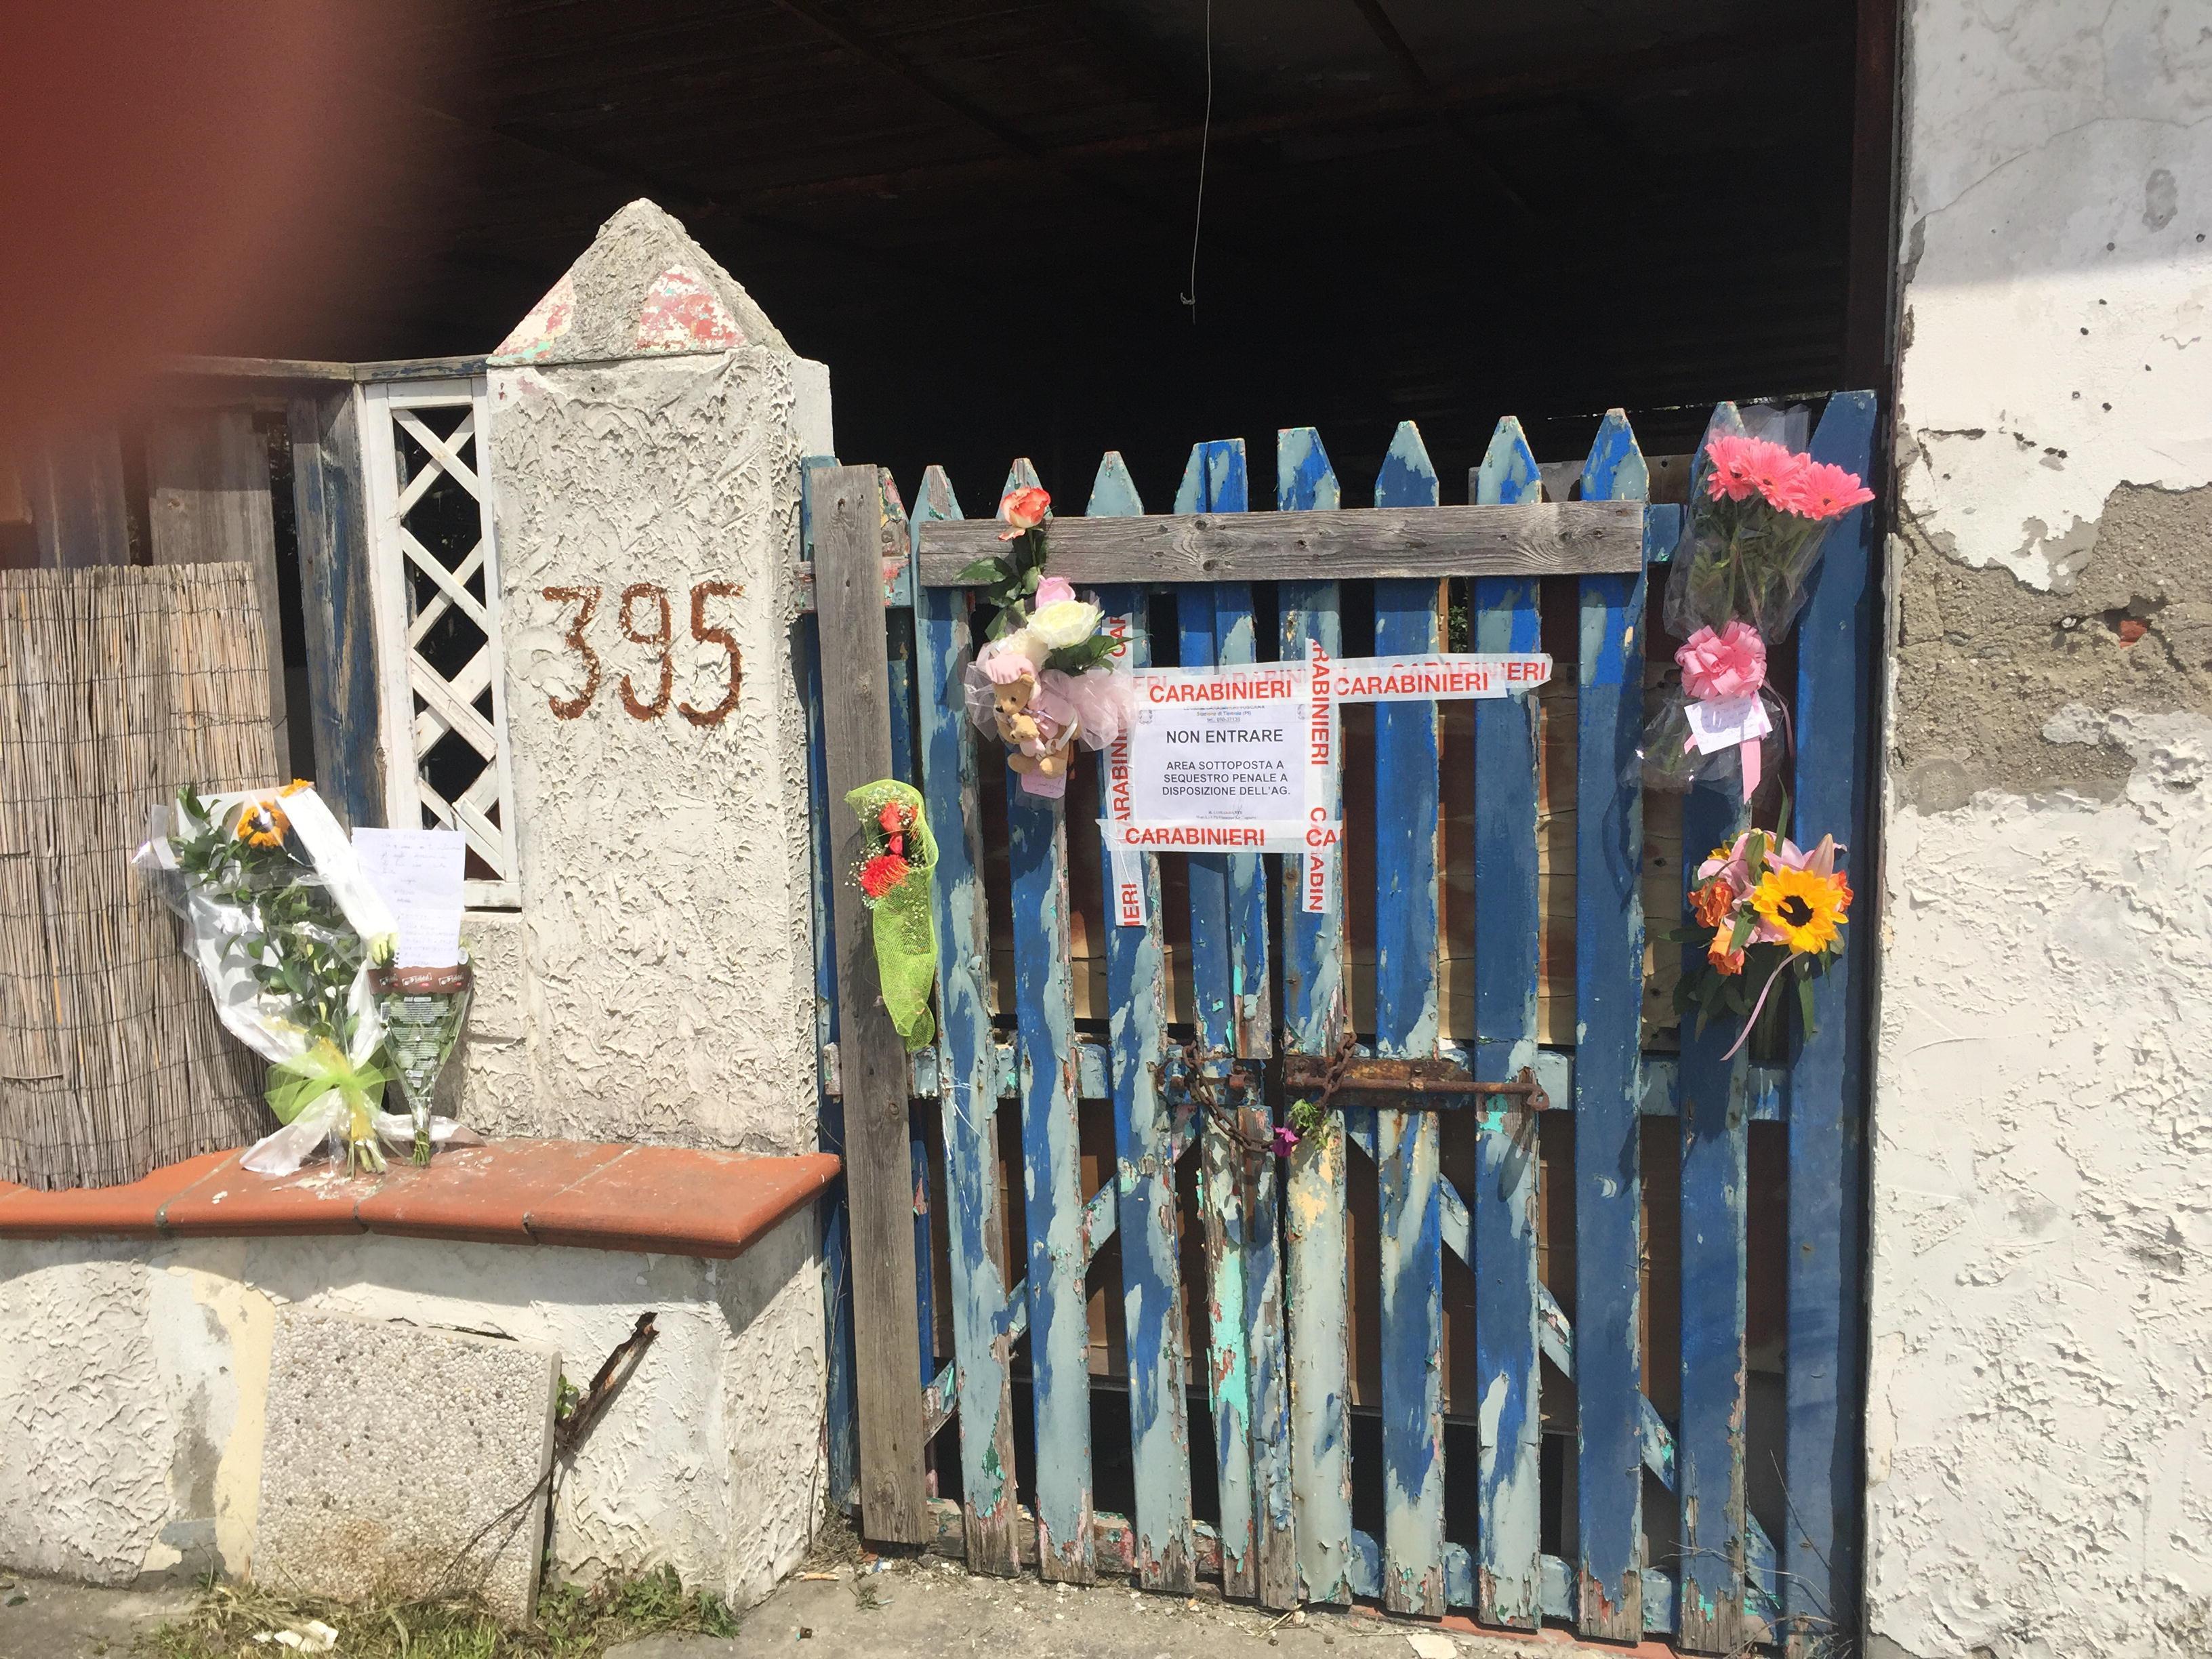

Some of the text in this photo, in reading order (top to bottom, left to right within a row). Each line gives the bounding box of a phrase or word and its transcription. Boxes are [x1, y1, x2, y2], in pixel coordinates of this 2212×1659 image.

[541, 581, 745, 726] 395
[1149, 680, 1292, 703] CARABINIERI
[1334, 672, 1488, 696] CARABINIERI
[1311, 640, 1330, 765] RABINIERI
[1166, 729, 1284, 743] NON ENTRARE
[1166, 760, 1285, 771] AREA SOTTOPOSTA A
[1164, 773, 1288, 783] SEQUESTRO PENALE A
[1162, 786, 1291, 796] DISPOSIZIONE DELL'AG.
[1126, 827, 1265, 846] CARABINIERI
